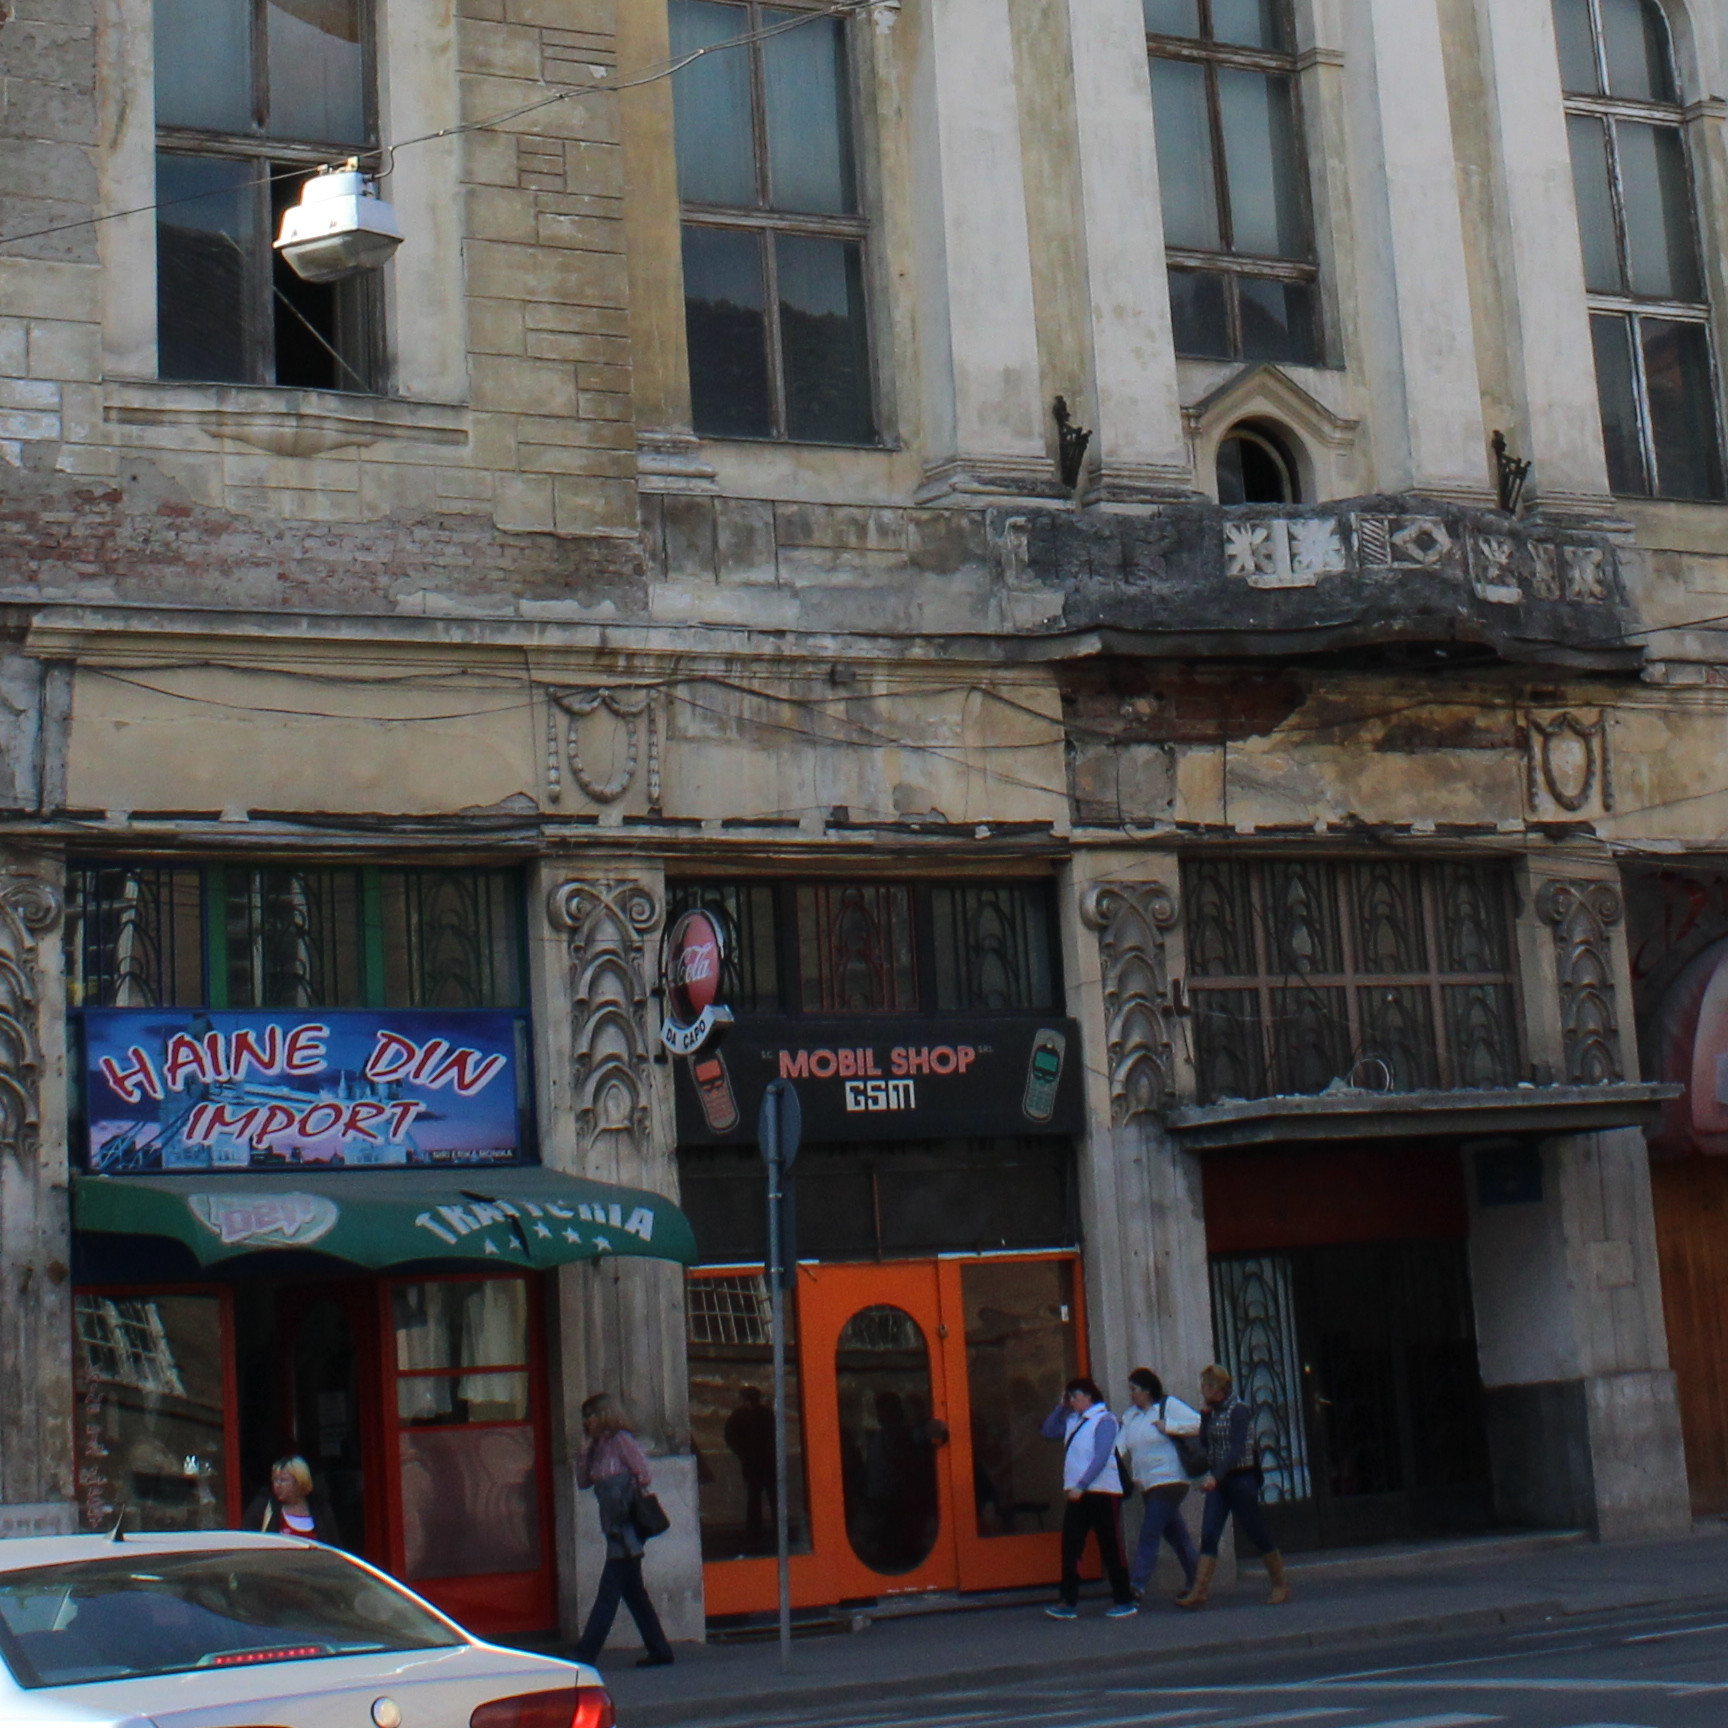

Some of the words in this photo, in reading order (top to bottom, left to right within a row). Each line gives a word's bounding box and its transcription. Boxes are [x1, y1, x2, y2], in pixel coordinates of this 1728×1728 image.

[666, 1028, 676, 1047] DA
[683, 1020, 706, 1049] CAPO
[100, 1024, 330, 1104] HAINE
[366, 1029, 507, 1096] DIN
[779, 1048, 882, 1079] MOBIL
[889, 1045, 975, 1076] SHOP
[845, 1079, 915, 1112] GSM
[184, 1101, 426, 1150] IMPORT
